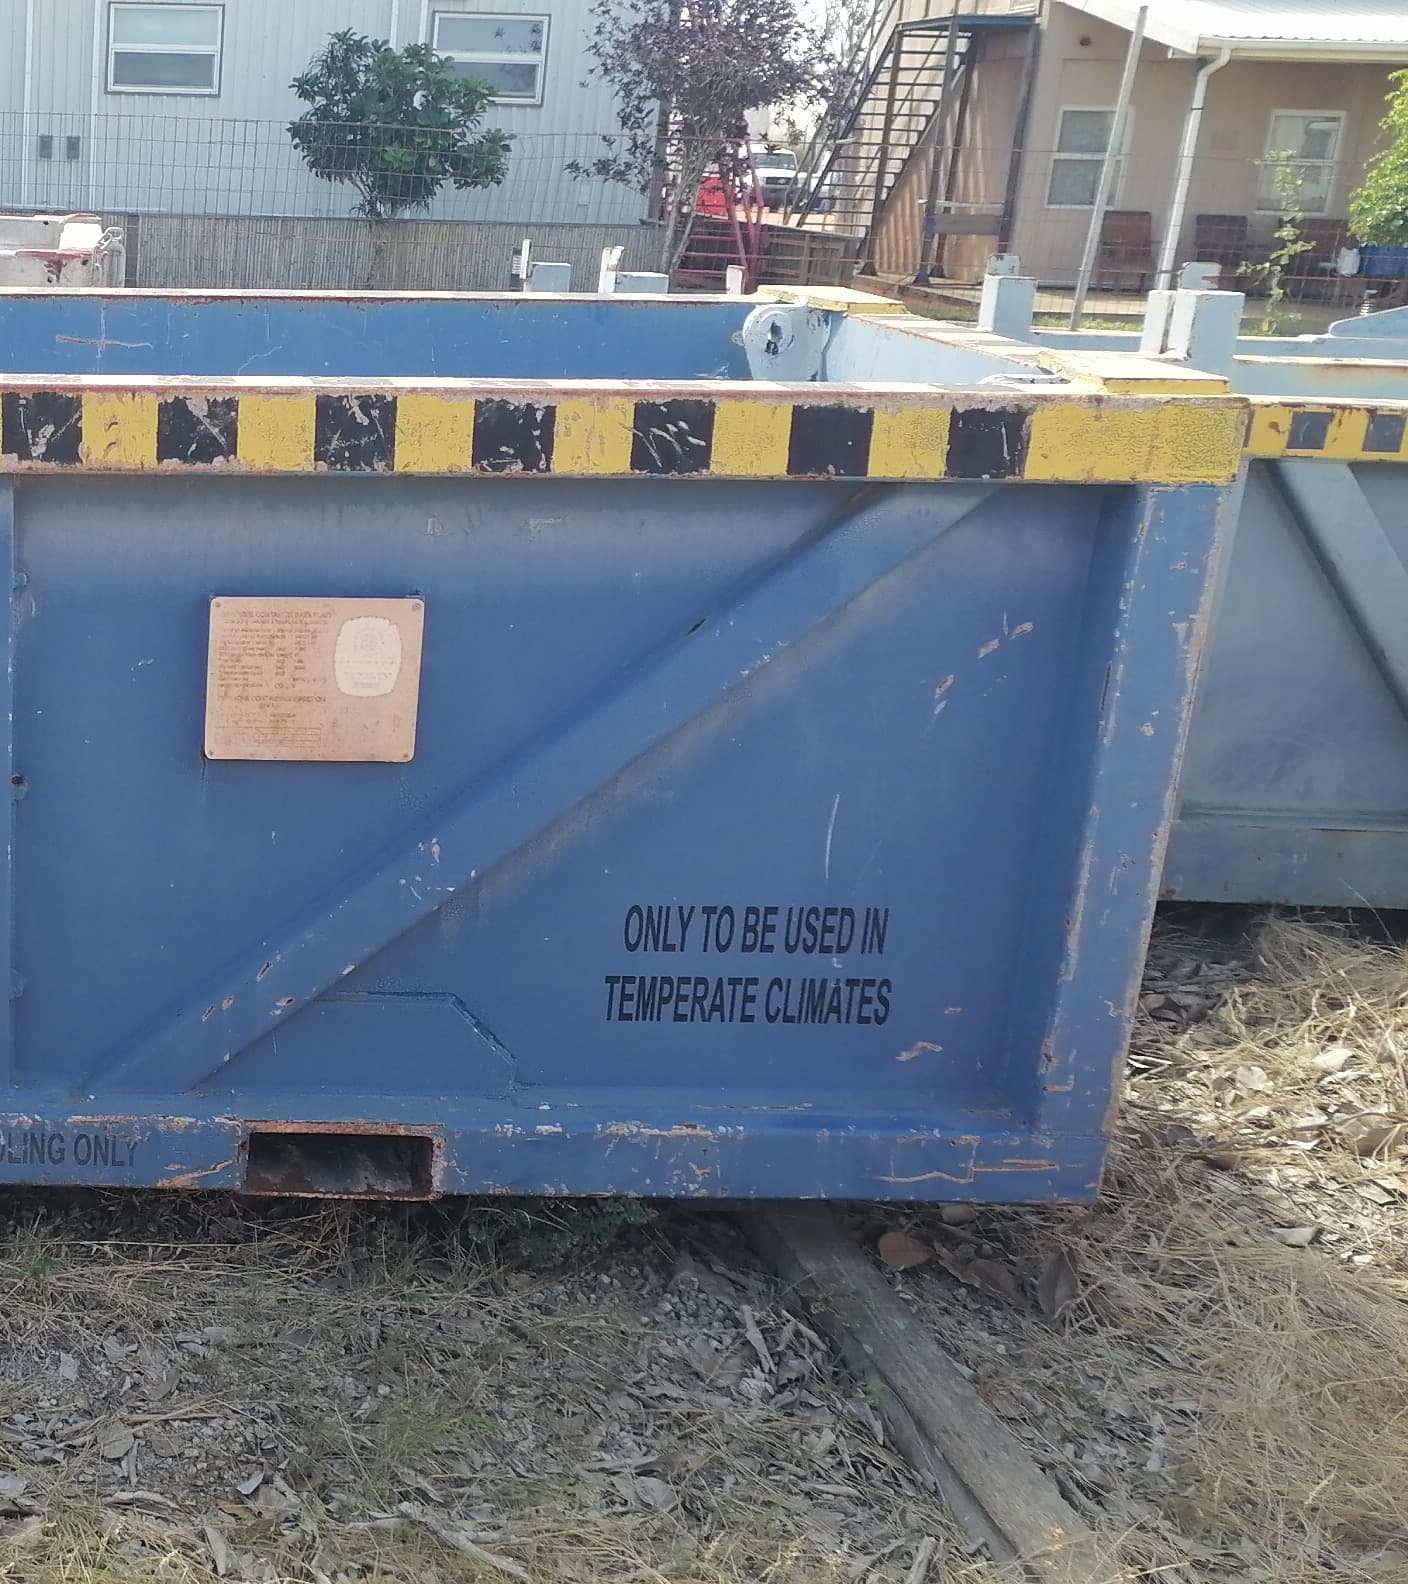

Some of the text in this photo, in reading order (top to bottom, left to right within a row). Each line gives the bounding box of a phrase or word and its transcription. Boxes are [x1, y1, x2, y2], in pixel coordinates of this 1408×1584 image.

[624, 905, 889, 955] ONLY TO BE USED IN
[604, 975, 892, 1025] TEMPERATE CLIMATES
[73, 1133, 138, 1167] ONLY
